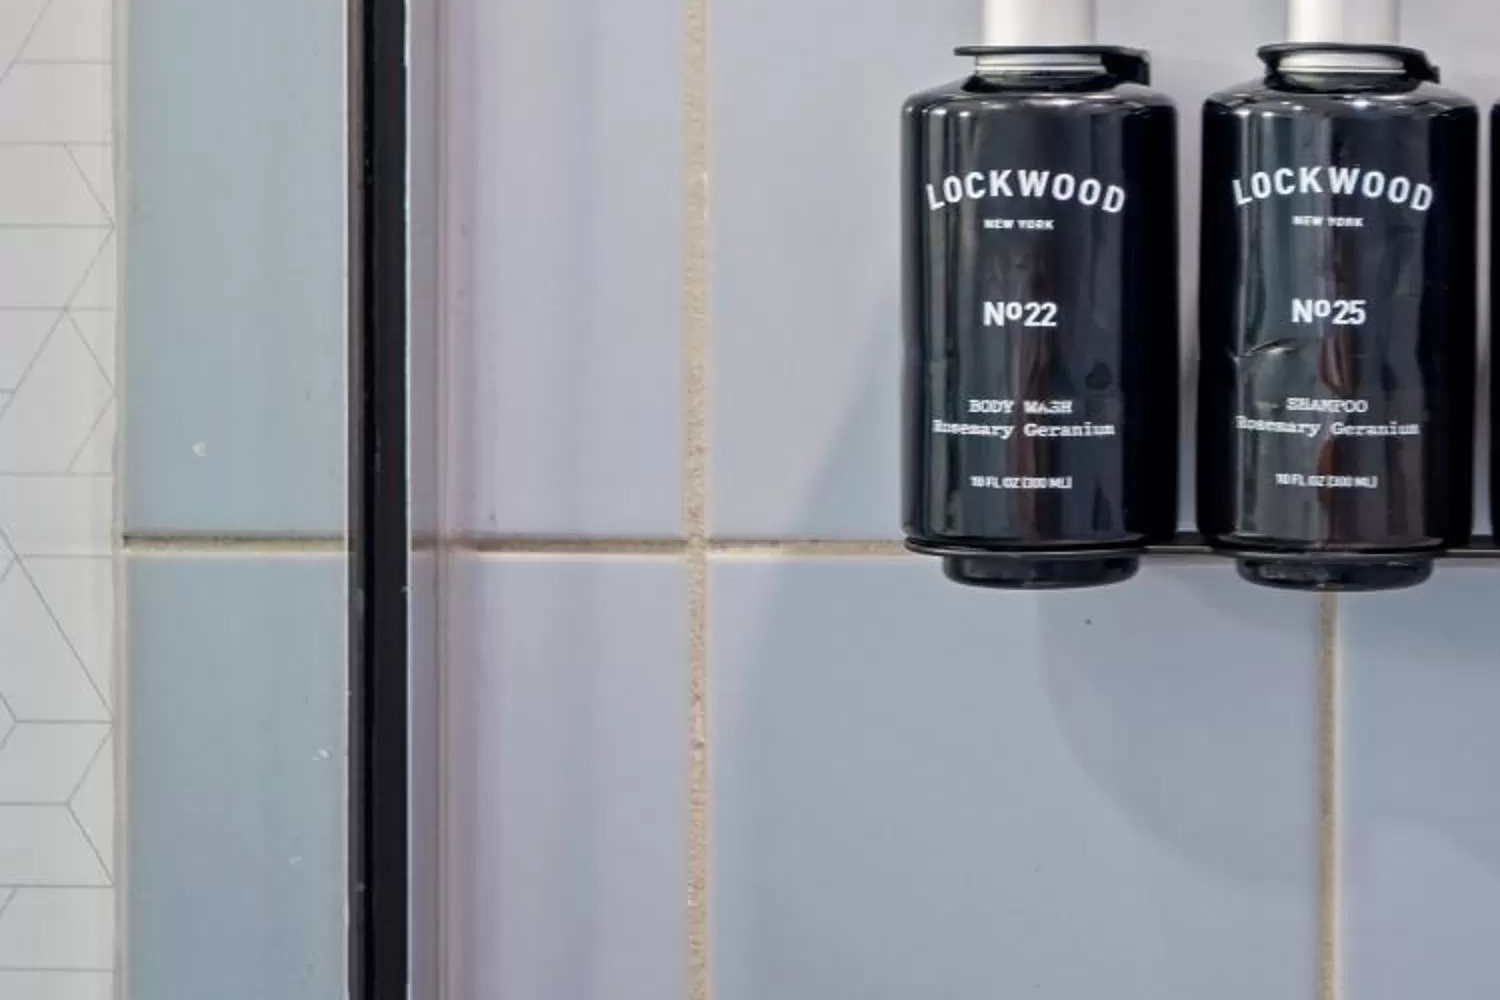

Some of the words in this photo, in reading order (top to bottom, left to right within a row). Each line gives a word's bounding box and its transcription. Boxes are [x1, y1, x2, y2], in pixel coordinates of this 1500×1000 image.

[925, 169, 1126, 213] LOCKWOOD
[1231, 166, 1434, 211] LOCKWOOD
[983, 218, 1014, 229] NEW
[1017, 219, 1055, 230] YORK
[1292, 215, 1324, 226] NEW
[1327, 216, 1364, 227] YORK
[968, 398, 1015, 414] BODY
[1023, 399, 1073, 414] WASH
[1286, 397, 1369, 413] SHAMPOO
[932, 418, 1015, 440] Rosemary
[1023, 421, 1116, 437] Geranium
[1235, 415, 1322, 437] Rosemary
[1330, 420, 1421, 437] Geranium
